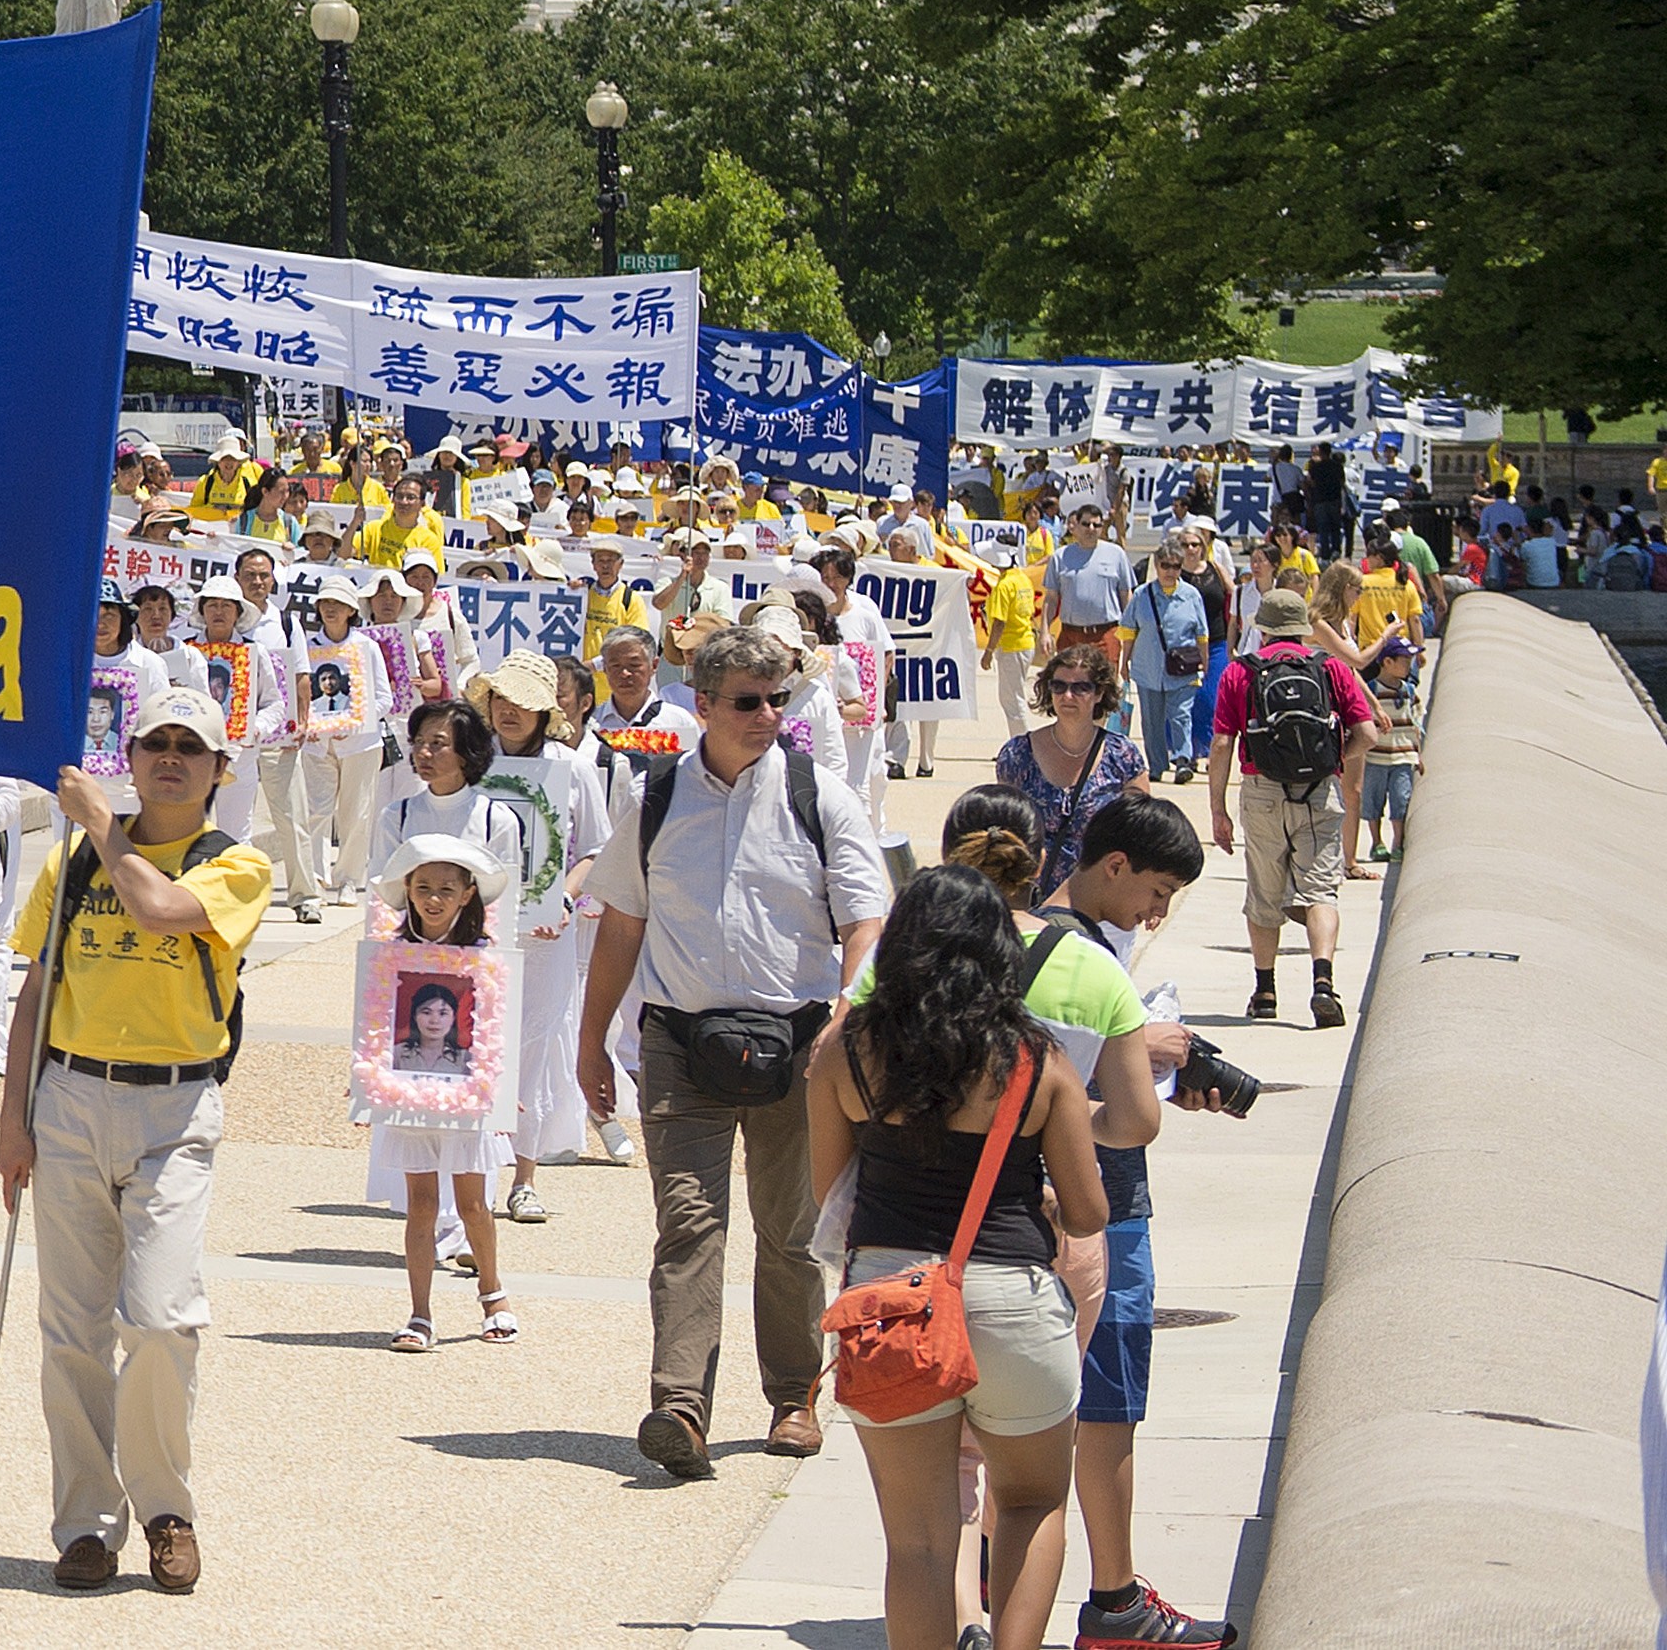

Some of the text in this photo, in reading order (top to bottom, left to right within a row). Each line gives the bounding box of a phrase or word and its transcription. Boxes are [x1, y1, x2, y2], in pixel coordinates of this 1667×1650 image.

[623, 255, 666, 269] FIRST
[370, 285, 675, 342] 疏而不漏
[369, 341, 672, 412] 善惡必報
[980, 378, 1213, 438] 解体中共
[1065, 471, 1094, 495] Camp
[856, 573, 938, 627] ong
[894, 649, 961, 702] ina
